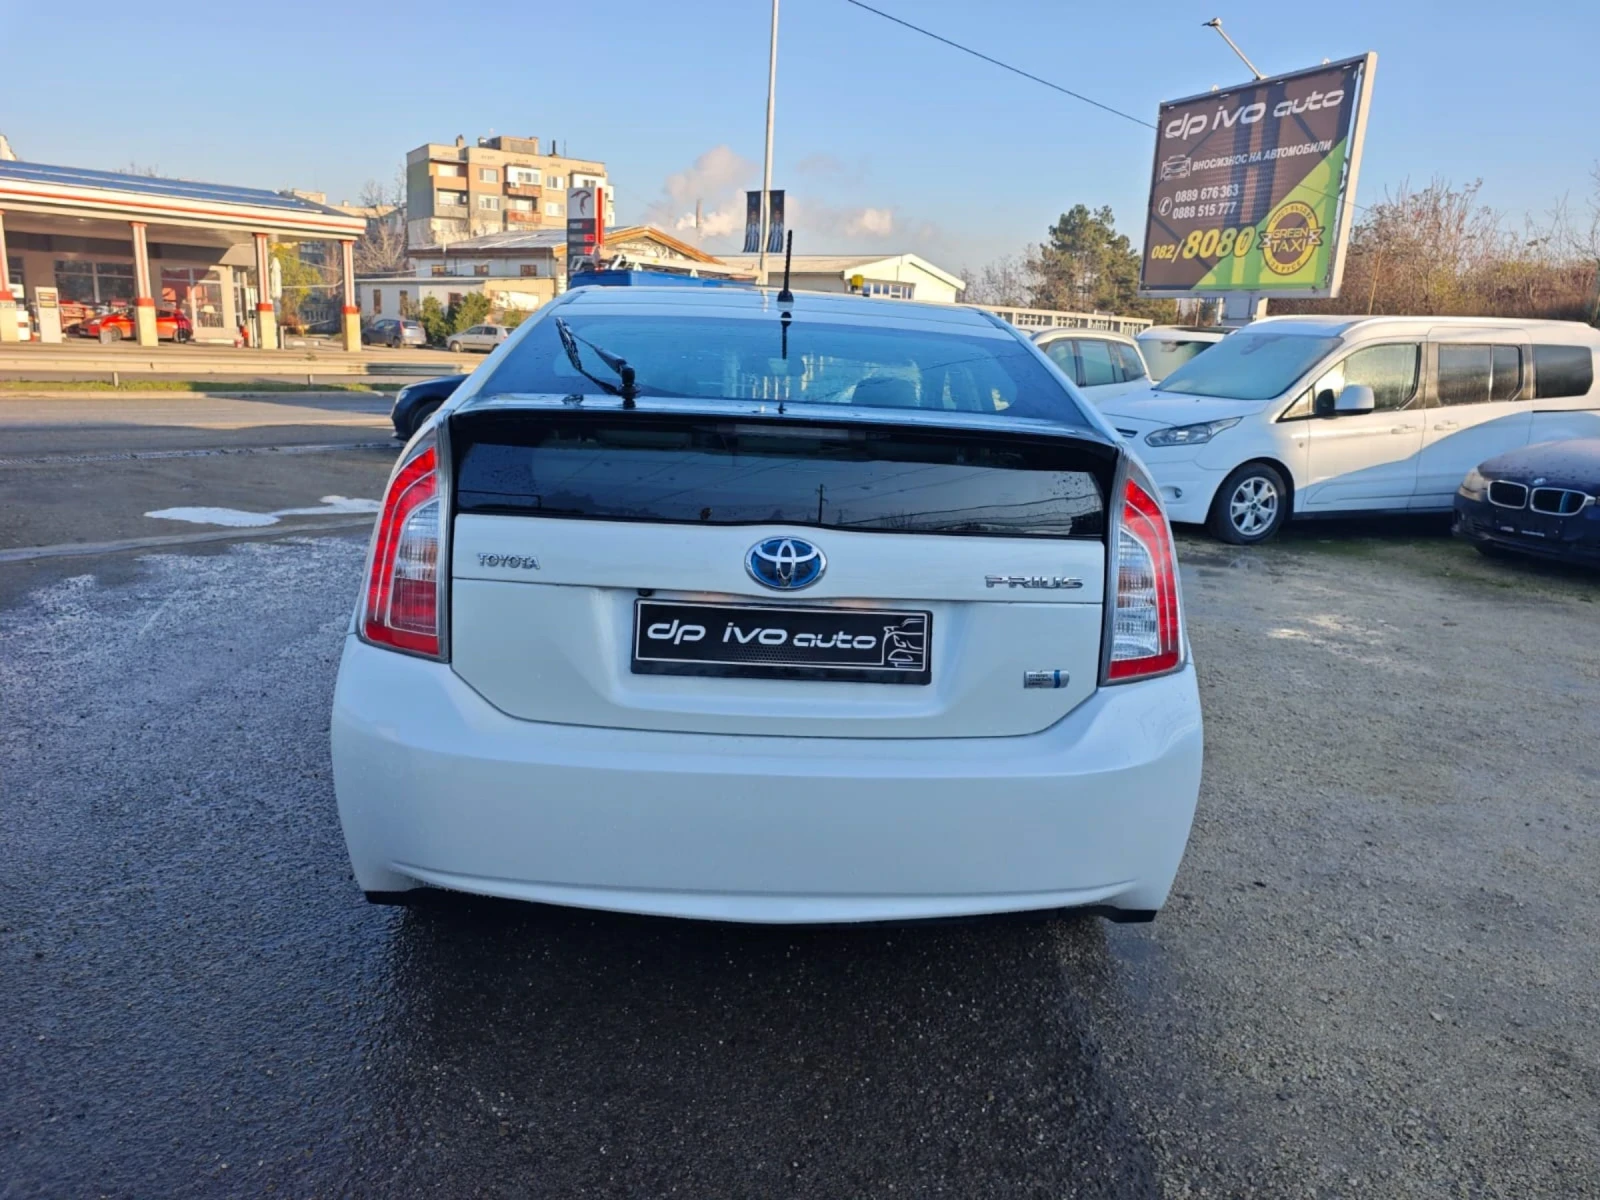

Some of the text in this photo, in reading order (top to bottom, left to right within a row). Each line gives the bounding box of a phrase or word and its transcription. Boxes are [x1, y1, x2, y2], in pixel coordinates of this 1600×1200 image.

[1165, 89, 1344, 140] dp ivo auto
[1248, 151, 1262, 162] НА
[1263, 140, 1332, 160] АВТОМОБИЛИ
[1175, 183, 1239, 203] 0889 676 363
[1172, 201, 1237, 219] 0888 515 777
[1272, 227, 1309, 239] GREEN
[1271, 238, 1307, 253] TAXI
[477, 553, 541, 570] TOYOTA
[985, 576, 1084, 589] PRIUS
[647, 619, 877, 649] dp ivo auto
